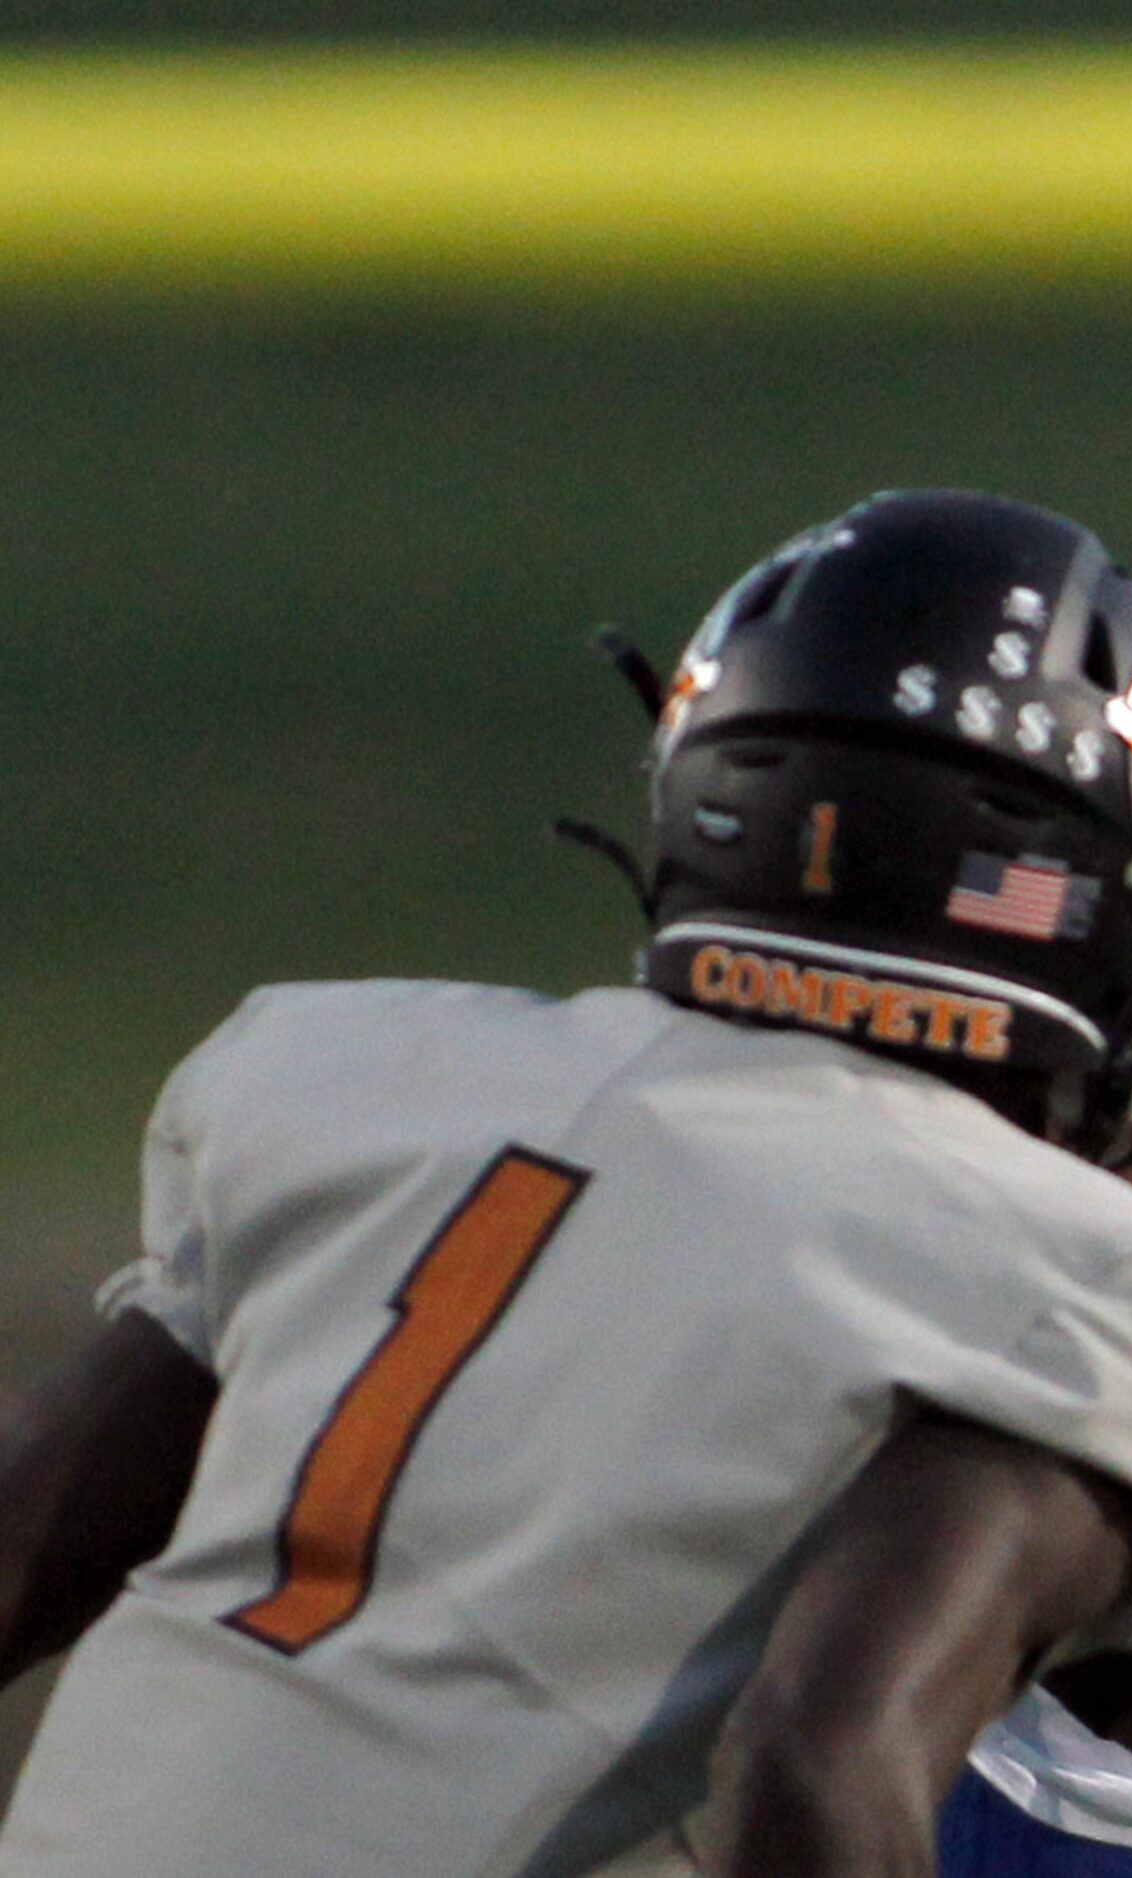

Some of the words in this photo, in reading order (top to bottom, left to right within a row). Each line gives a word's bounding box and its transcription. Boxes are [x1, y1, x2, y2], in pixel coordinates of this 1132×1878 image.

[802, 801, 838, 893] 1
[690, 945, 1012, 1062] COMPETE
[215, 1142, 594, 1657] 1
